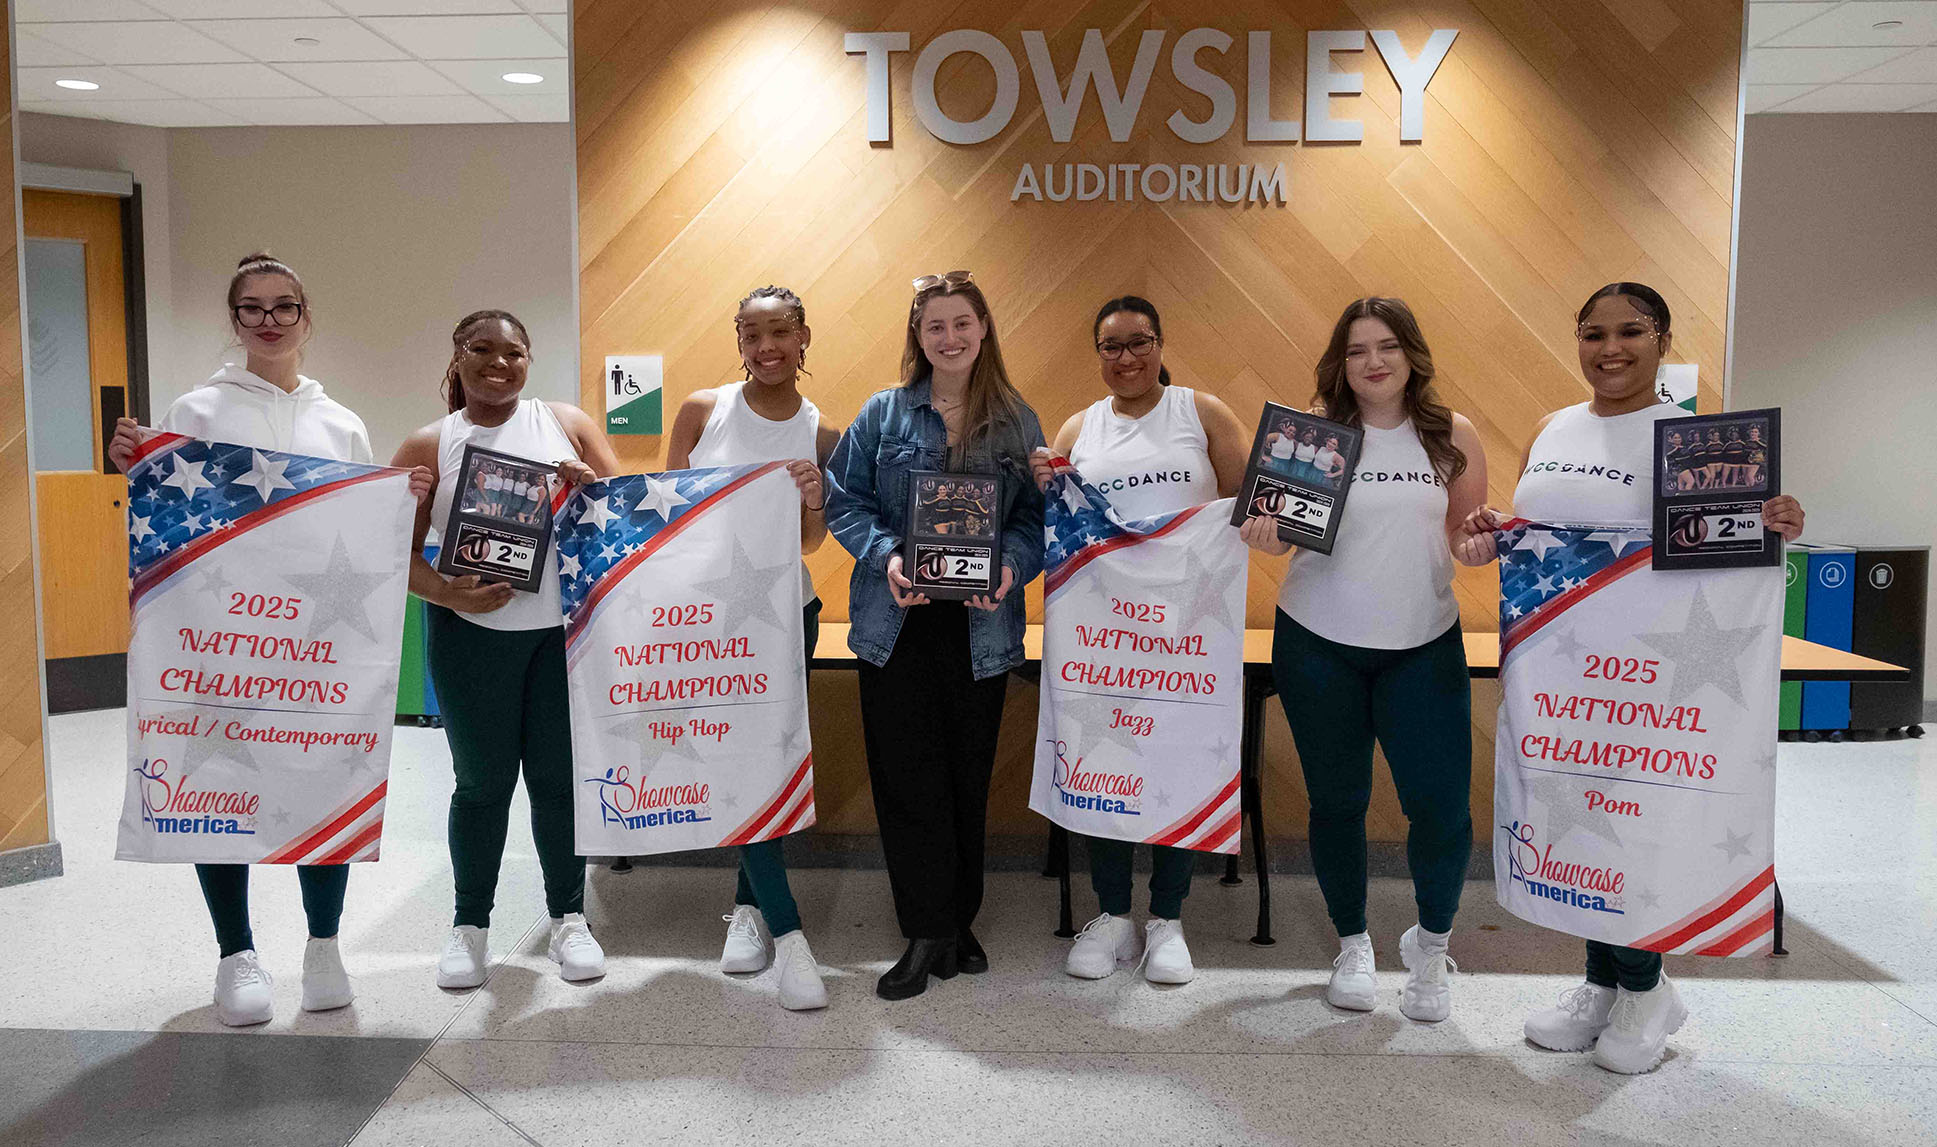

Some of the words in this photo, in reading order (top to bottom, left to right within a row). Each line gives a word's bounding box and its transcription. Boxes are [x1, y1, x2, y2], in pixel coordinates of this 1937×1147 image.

[844, 27, 1461, 147] TOWSLEY
[1011, 162, 1288, 205] AUDITORIUM
[610, 417, 629, 425] MEN
[1260, 477, 1285, 488] DANCE
[1287, 486, 1308, 495] TEAM
[1309, 493, 1332, 503] UNION
[1292, 500, 1323, 519] 2ND
[491, 531, 512, 539] TEAM
[1718, 517, 1755, 538] 2ND
[497, 545, 528, 563] 2ND
[955, 558, 984, 576] 2ND
[228, 592, 302, 620] 2025
[651, 603, 714, 627] 2025
[1111, 597, 1166, 624] 2025
[179, 628, 338, 664] NATIONAL
[614, 636, 756, 667] NATIONAL
[1076, 625, 1208, 656] NATIONAL
[1061, 660, 1217, 695] CHAMPIONS
[1583, 654, 1660, 684] 2025
[160, 667, 349, 704] CHAMPIONS
[609, 673, 768, 706] CHAMPIONS
[1109, 708, 1155, 736] Jazz
[1534, 692, 1707, 734] NATIONAL
[137, 714, 200, 742] yrical
[224, 721, 380, 753] Contemporary
[648, 721, 686, 745] Hip
[689, 719, 732, 742] Hop
[1056, 740, 1144, 797] Showcase
[1520, 734, 1717, 780] CHAMPIONS
[149, 758, 260, 814] Showcase
[614, 765, 711, 813] Showcase
[1584, 790, 1642, 817] Pom
[1518, 823, 1624, 895] Showcase
